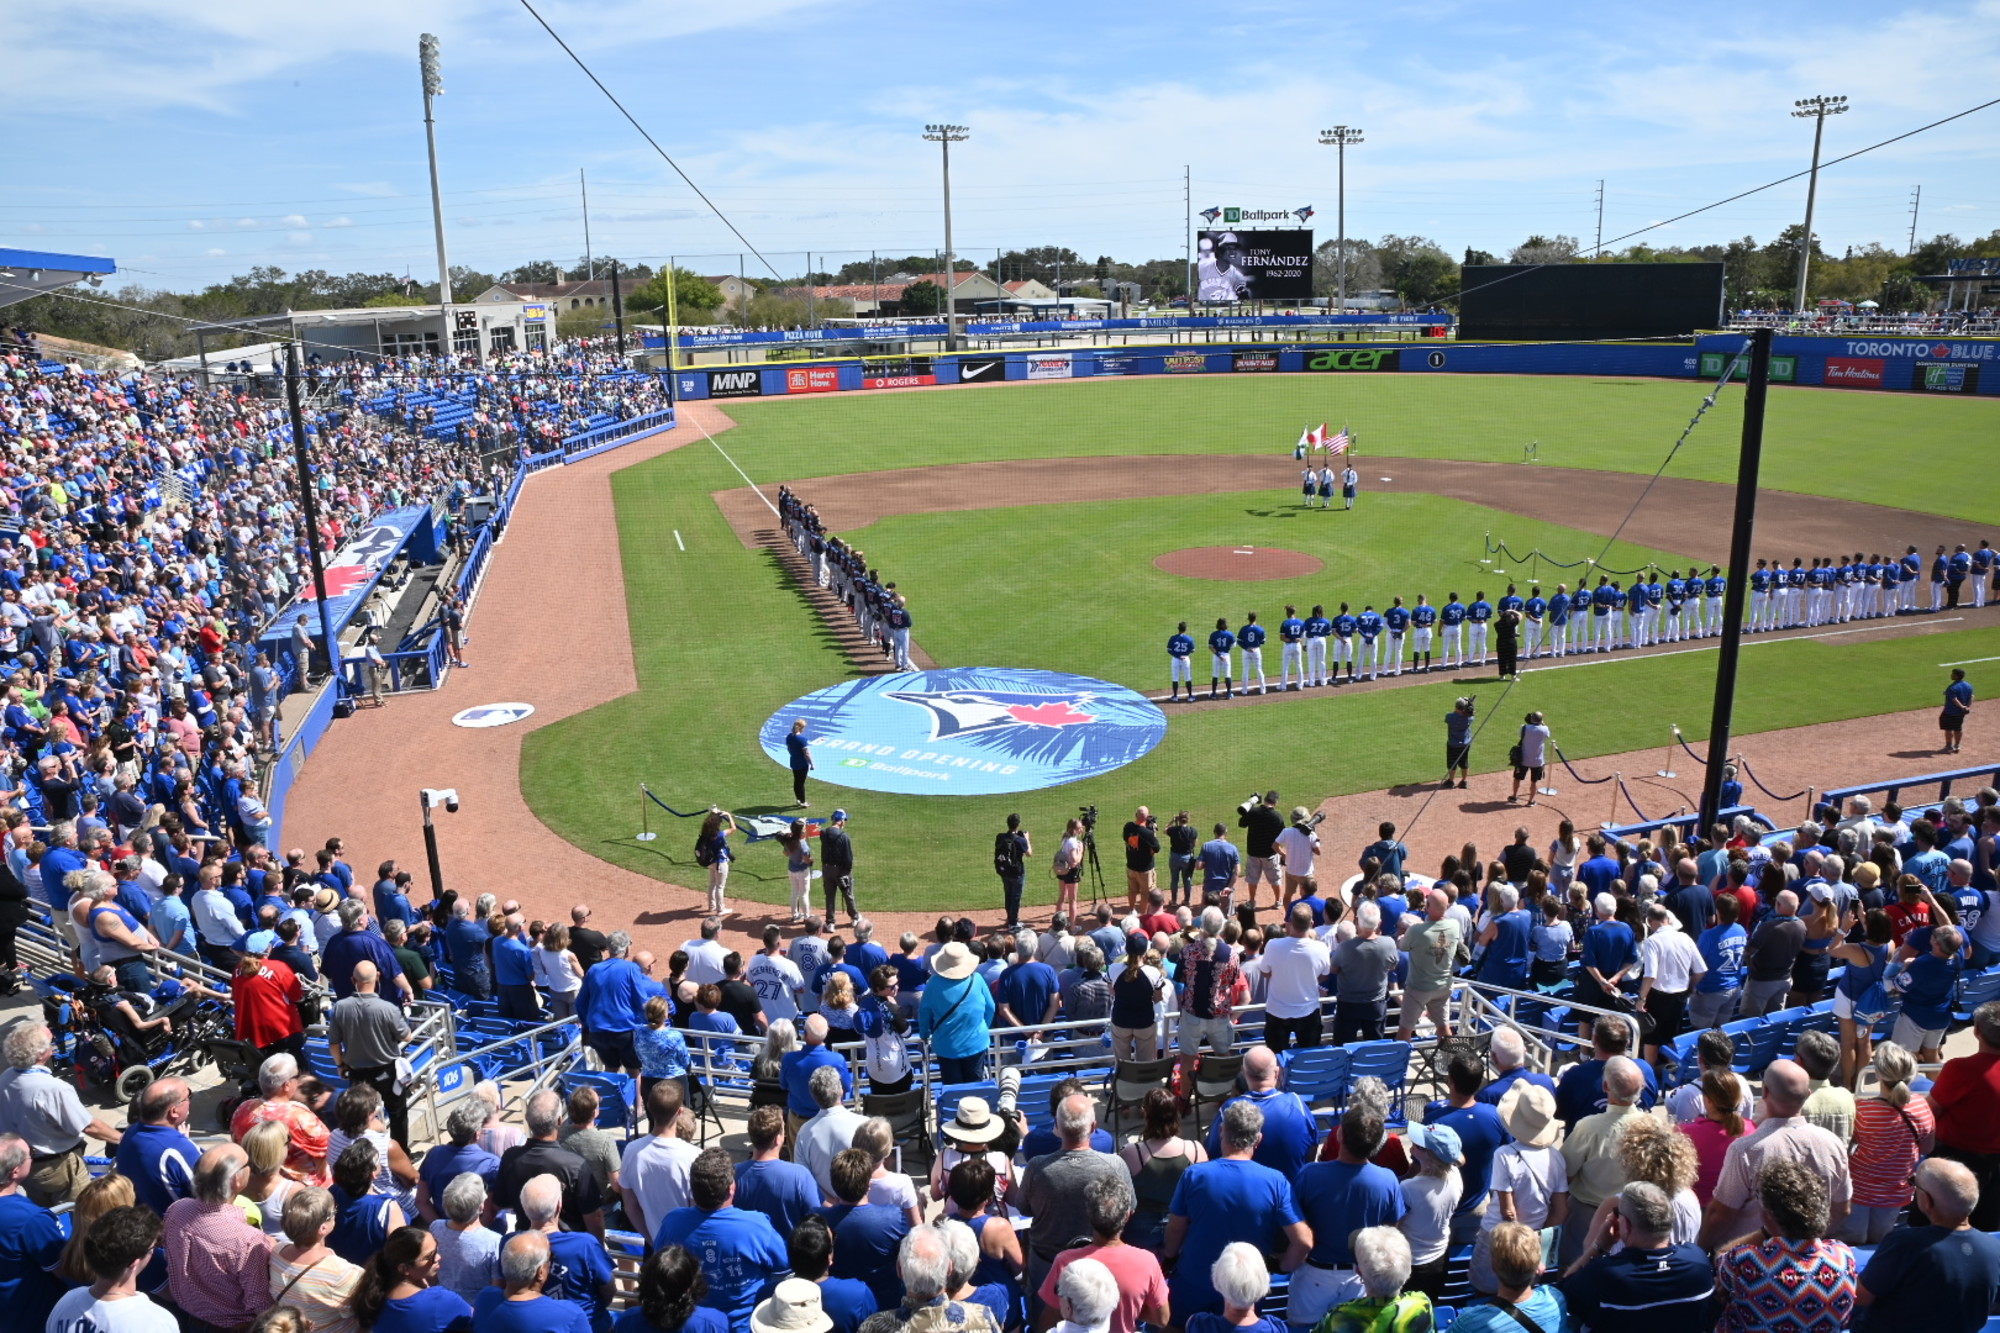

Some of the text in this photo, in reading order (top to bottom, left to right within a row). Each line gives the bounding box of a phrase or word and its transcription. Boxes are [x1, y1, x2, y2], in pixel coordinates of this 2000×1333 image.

[1241, 209, 1290, 222] Ballpark
[1241, 255, 1308, 266] FERNÁNDEZ
[1266, 269, 1302, 278] 1962-2020
[1149, 319, 1178, 327] MILNER
[784, 330, 803, 340] PIZZA
[1846, 341, 1995, 360] TORONTO BLUE
[1309, 350, 1394, 371] acer
[1703, 357, 1720, 372] TD
[809, 371, 836, 379] Here's
[1772, 361, 1792, 376] TD
[1827, 365, 1880, 380] Tim Hortons
[712, 372, 757, 391] MNP
[1360, 615, 1375, 625] 37
[1393, 614, 1401, 624] 3
[1449, 608, 1462, 620] 39
[1310, 622, 1326, 633] 27
[1340, 621, 1352, 632] 15
[1216, 637, 1227, 647] 11
[1247, 631, 1255, 642] 8
[1173, 641, 1188, 653] 25
[808, 736, 1020, 775] GRAND OPENING
[869, 762, 952, 781] Ballpark
[801, 953, 816, 972] 8
[1716, 946, 1745, 972] 27
[753, 979, 782, 1001] 27
[443, 1068, 459, 1088] 106
[705, 1248, 717, 1264] 8
[726, 1264, 743, 1278] 11
